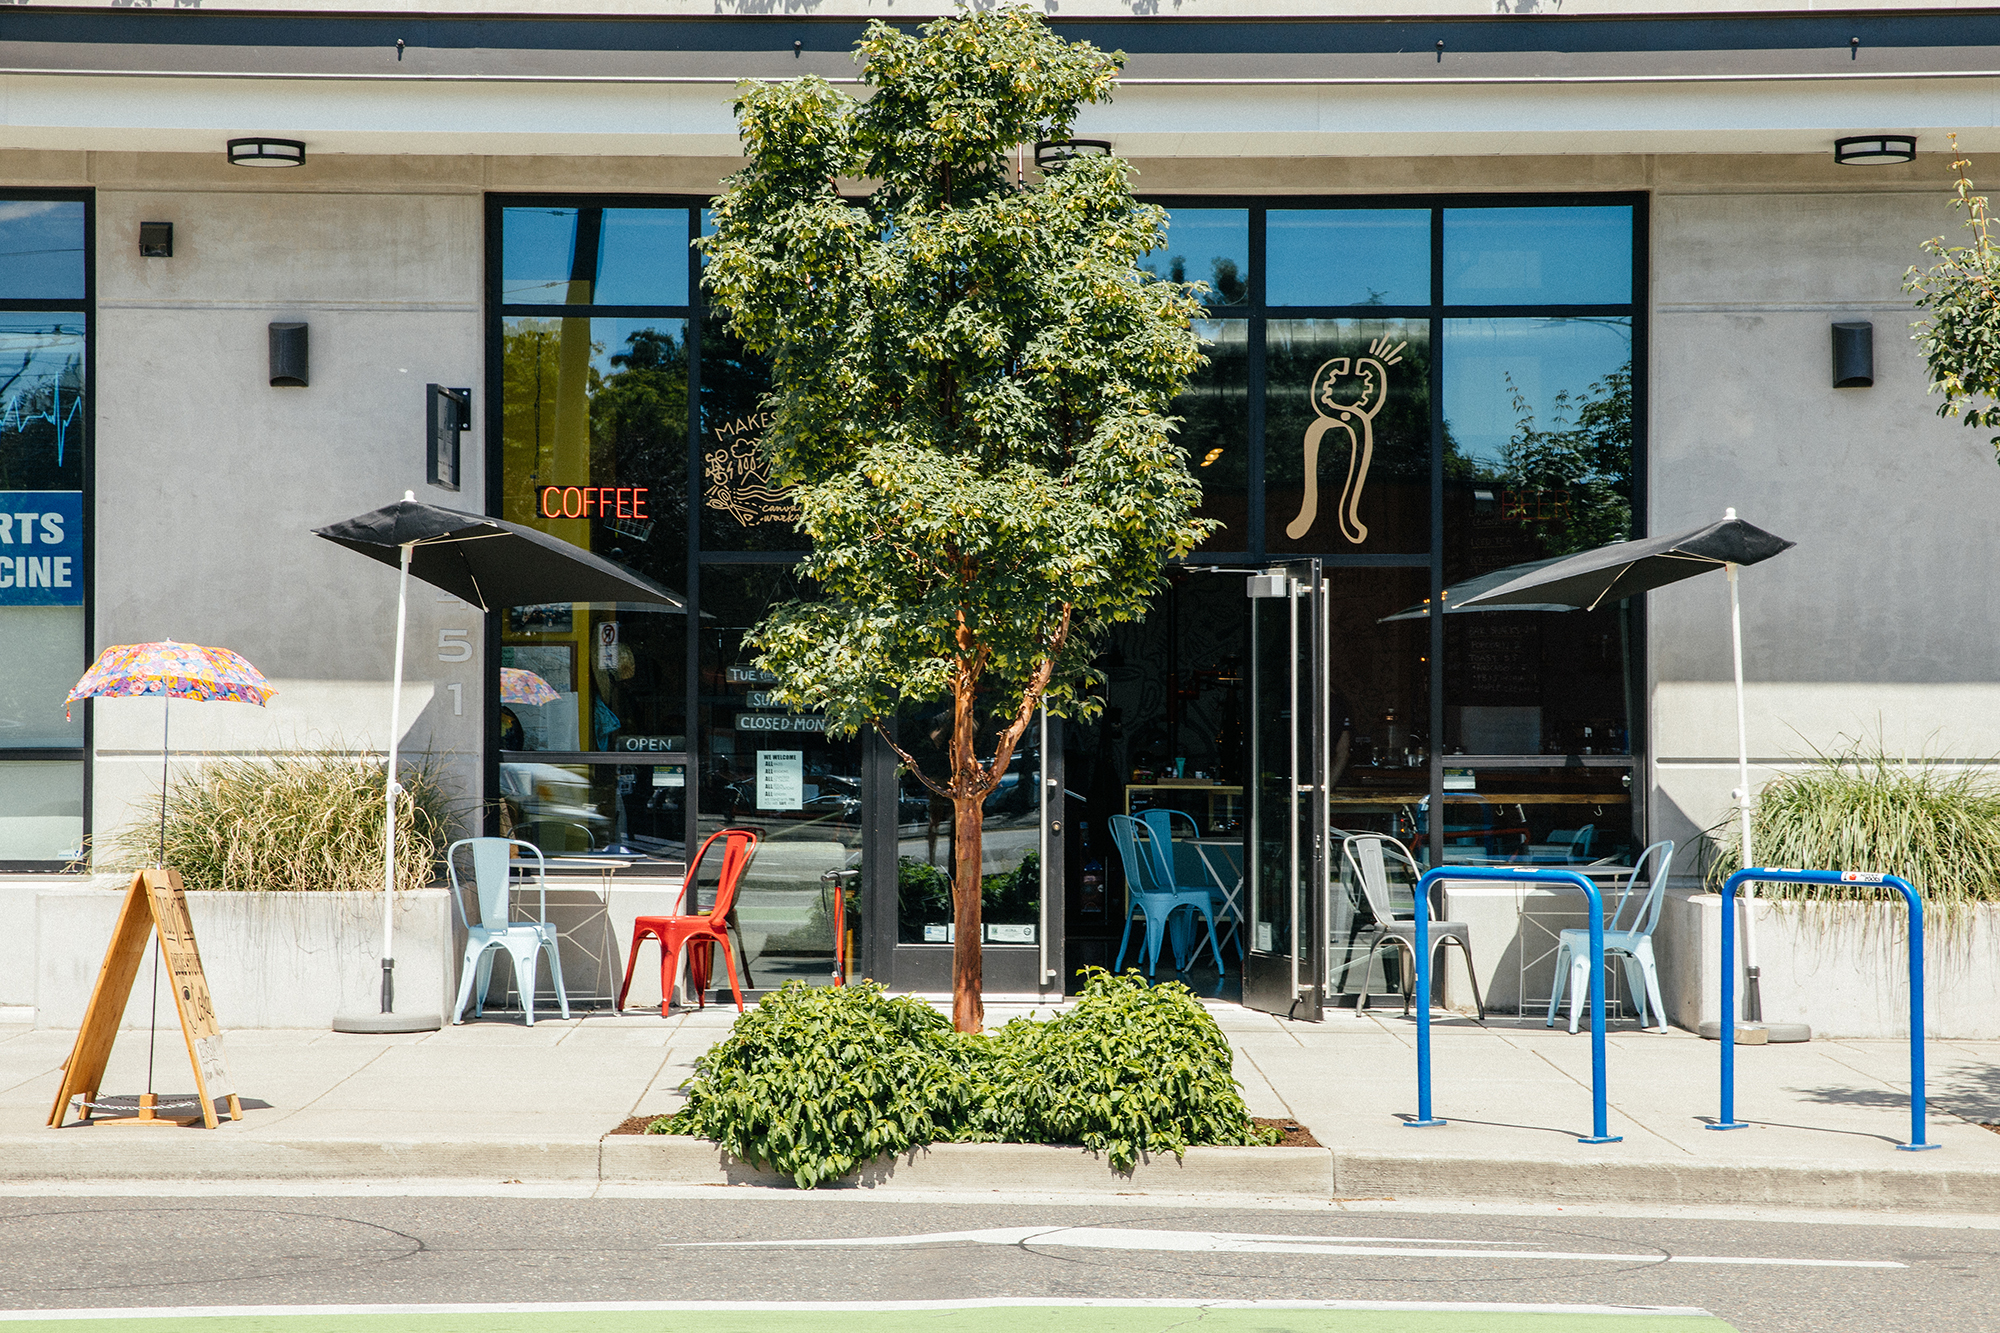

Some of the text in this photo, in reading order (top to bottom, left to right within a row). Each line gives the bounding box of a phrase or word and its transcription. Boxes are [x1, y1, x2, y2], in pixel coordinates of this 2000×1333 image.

[543, 486, 649, 519] COFFEE
[762, 504, 802, 512] canva
[1502, 490, 1571, 520] BEER
[0, 556, 72, 588] CINE
[730, 669, 757, 680] TUE
[626, 738, 671, 751] OPEN
